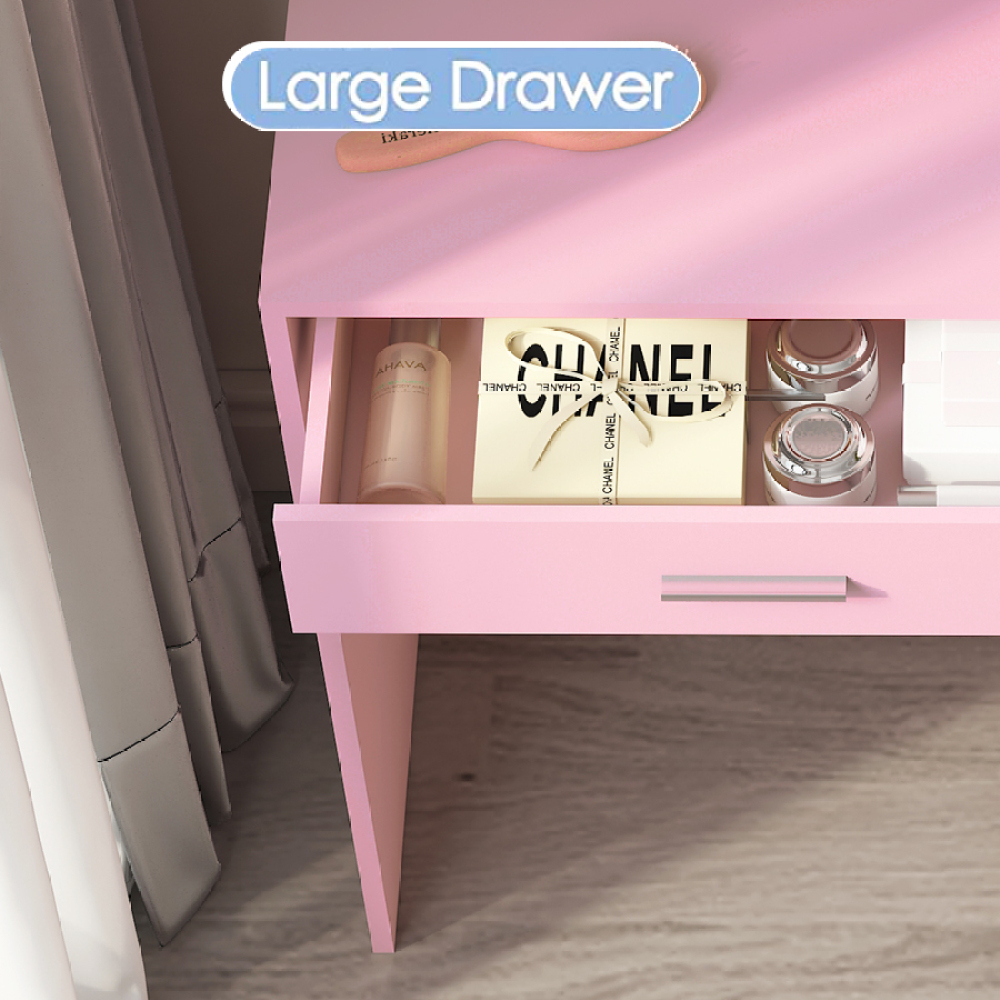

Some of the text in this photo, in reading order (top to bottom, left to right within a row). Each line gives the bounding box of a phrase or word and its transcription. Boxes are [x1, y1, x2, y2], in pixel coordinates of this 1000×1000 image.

[375, 360, 428, 378] AHAVA
[483, 382, 528, 392] CHANEL
[537, 382, 581, 392] CHANEL
[603, 413, 617, 450] CHANEL
[601, 456, 614, 494] CHANEL
